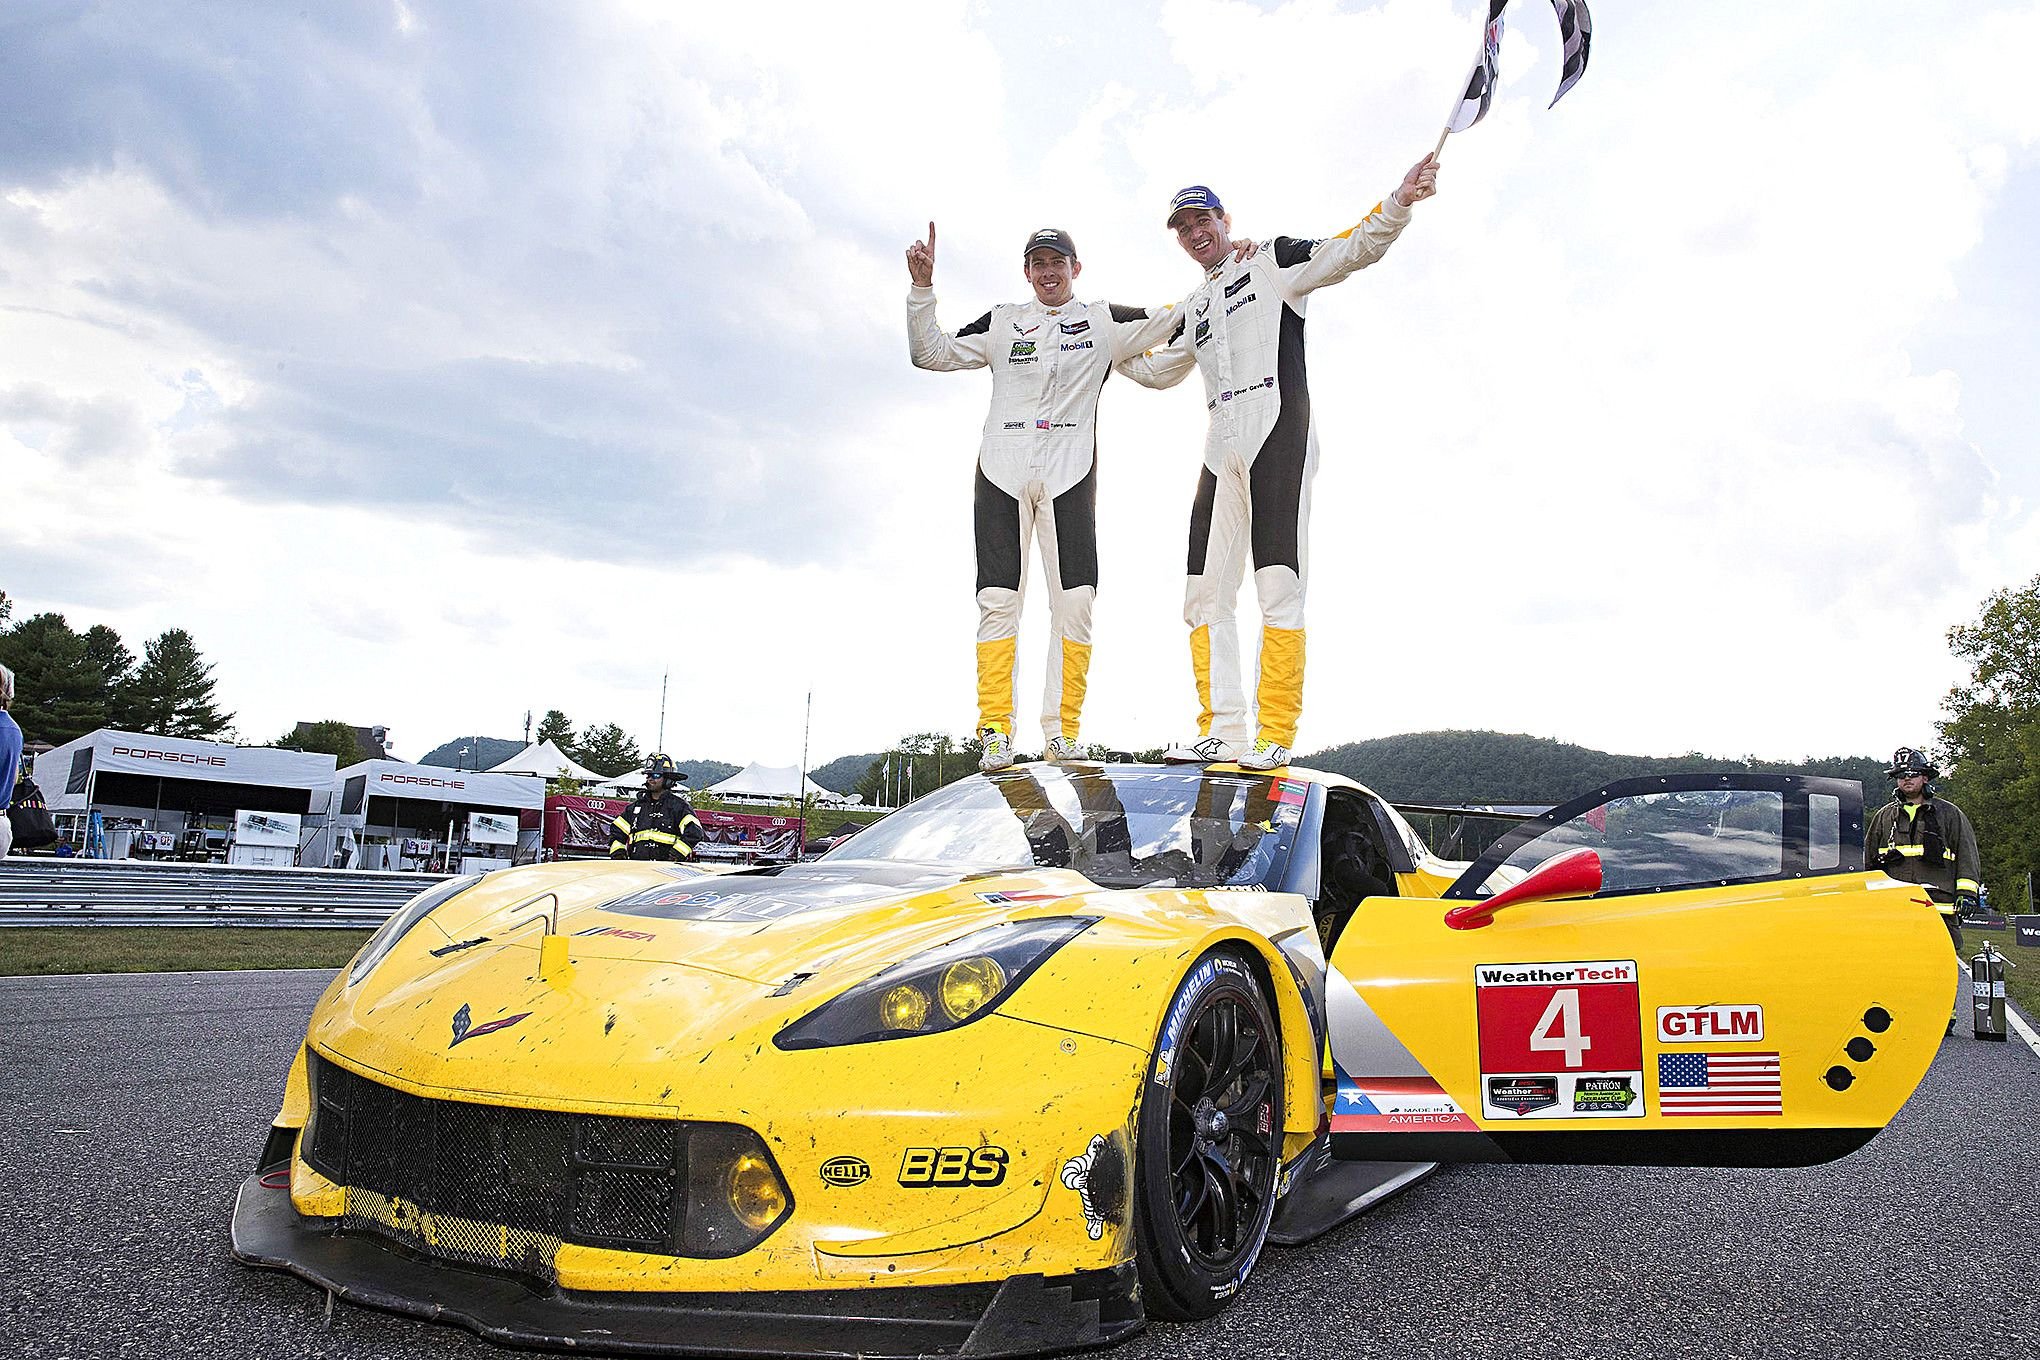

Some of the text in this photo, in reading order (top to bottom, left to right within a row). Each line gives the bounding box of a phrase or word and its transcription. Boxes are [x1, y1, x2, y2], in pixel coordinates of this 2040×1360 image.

[1226, 296, 1247, 317] Mobil
[1061, 342, 1085, 351] Mobil
[113, 747, 226, 766] PORSCHE
[1896, 753, 1910, 763] 17
[381, 774, 465, 789] PORSCHE
[1482, 967, 1628, 983] WeatherTech
[1167, 963, 1212, 1042] MICHELIN
[1530, 989, 1591, 1067] 4
[1662, 1011, 1759, 1036] GTLM
[1585, 1081, 1621, 1090] PATRÓN
[1388, 1115, 1461, 1124] AMERICA
[823, 1164, 870, 1178] HELLA
[897, 1146, 1009, 1188] BBS
